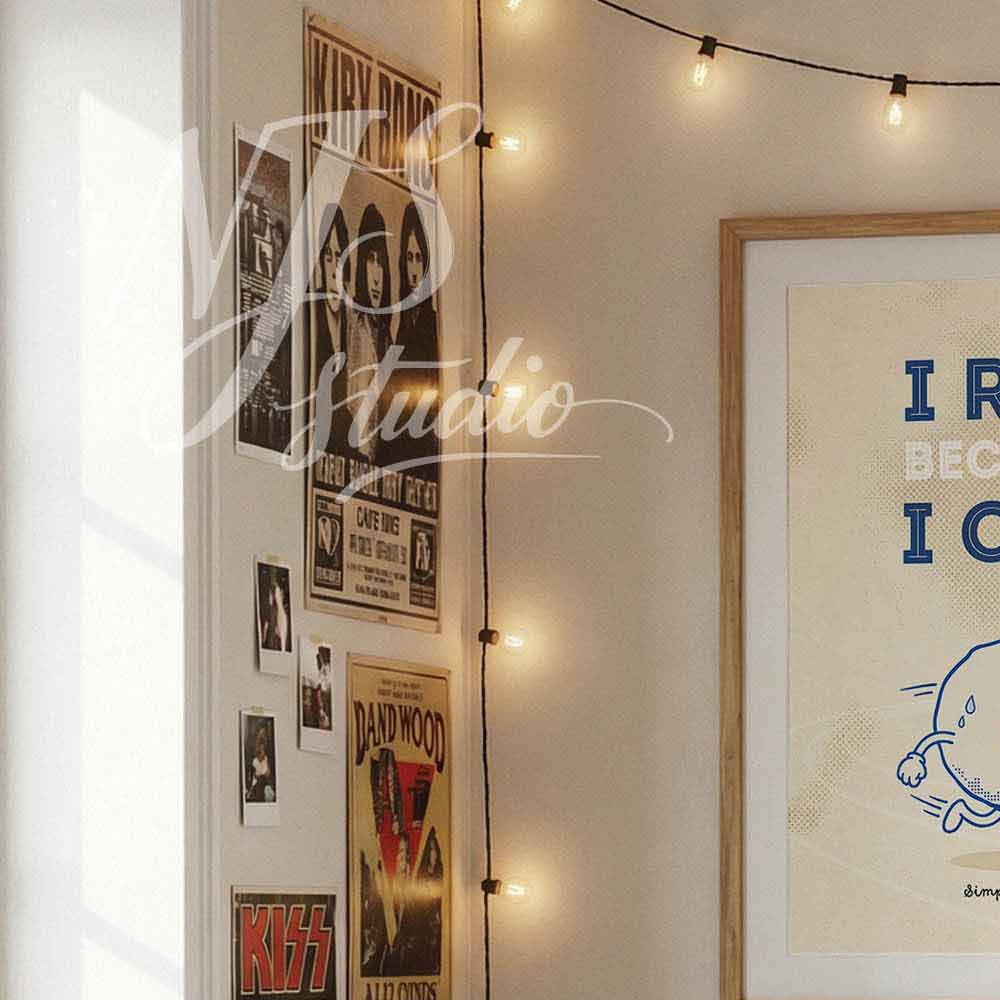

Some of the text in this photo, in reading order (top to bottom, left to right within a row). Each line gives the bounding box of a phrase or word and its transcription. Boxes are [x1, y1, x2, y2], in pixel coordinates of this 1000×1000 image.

[905, 360, 935, 421] I
[903, 502, 933, 564] I
[240, 903, 332, 995] KISS
